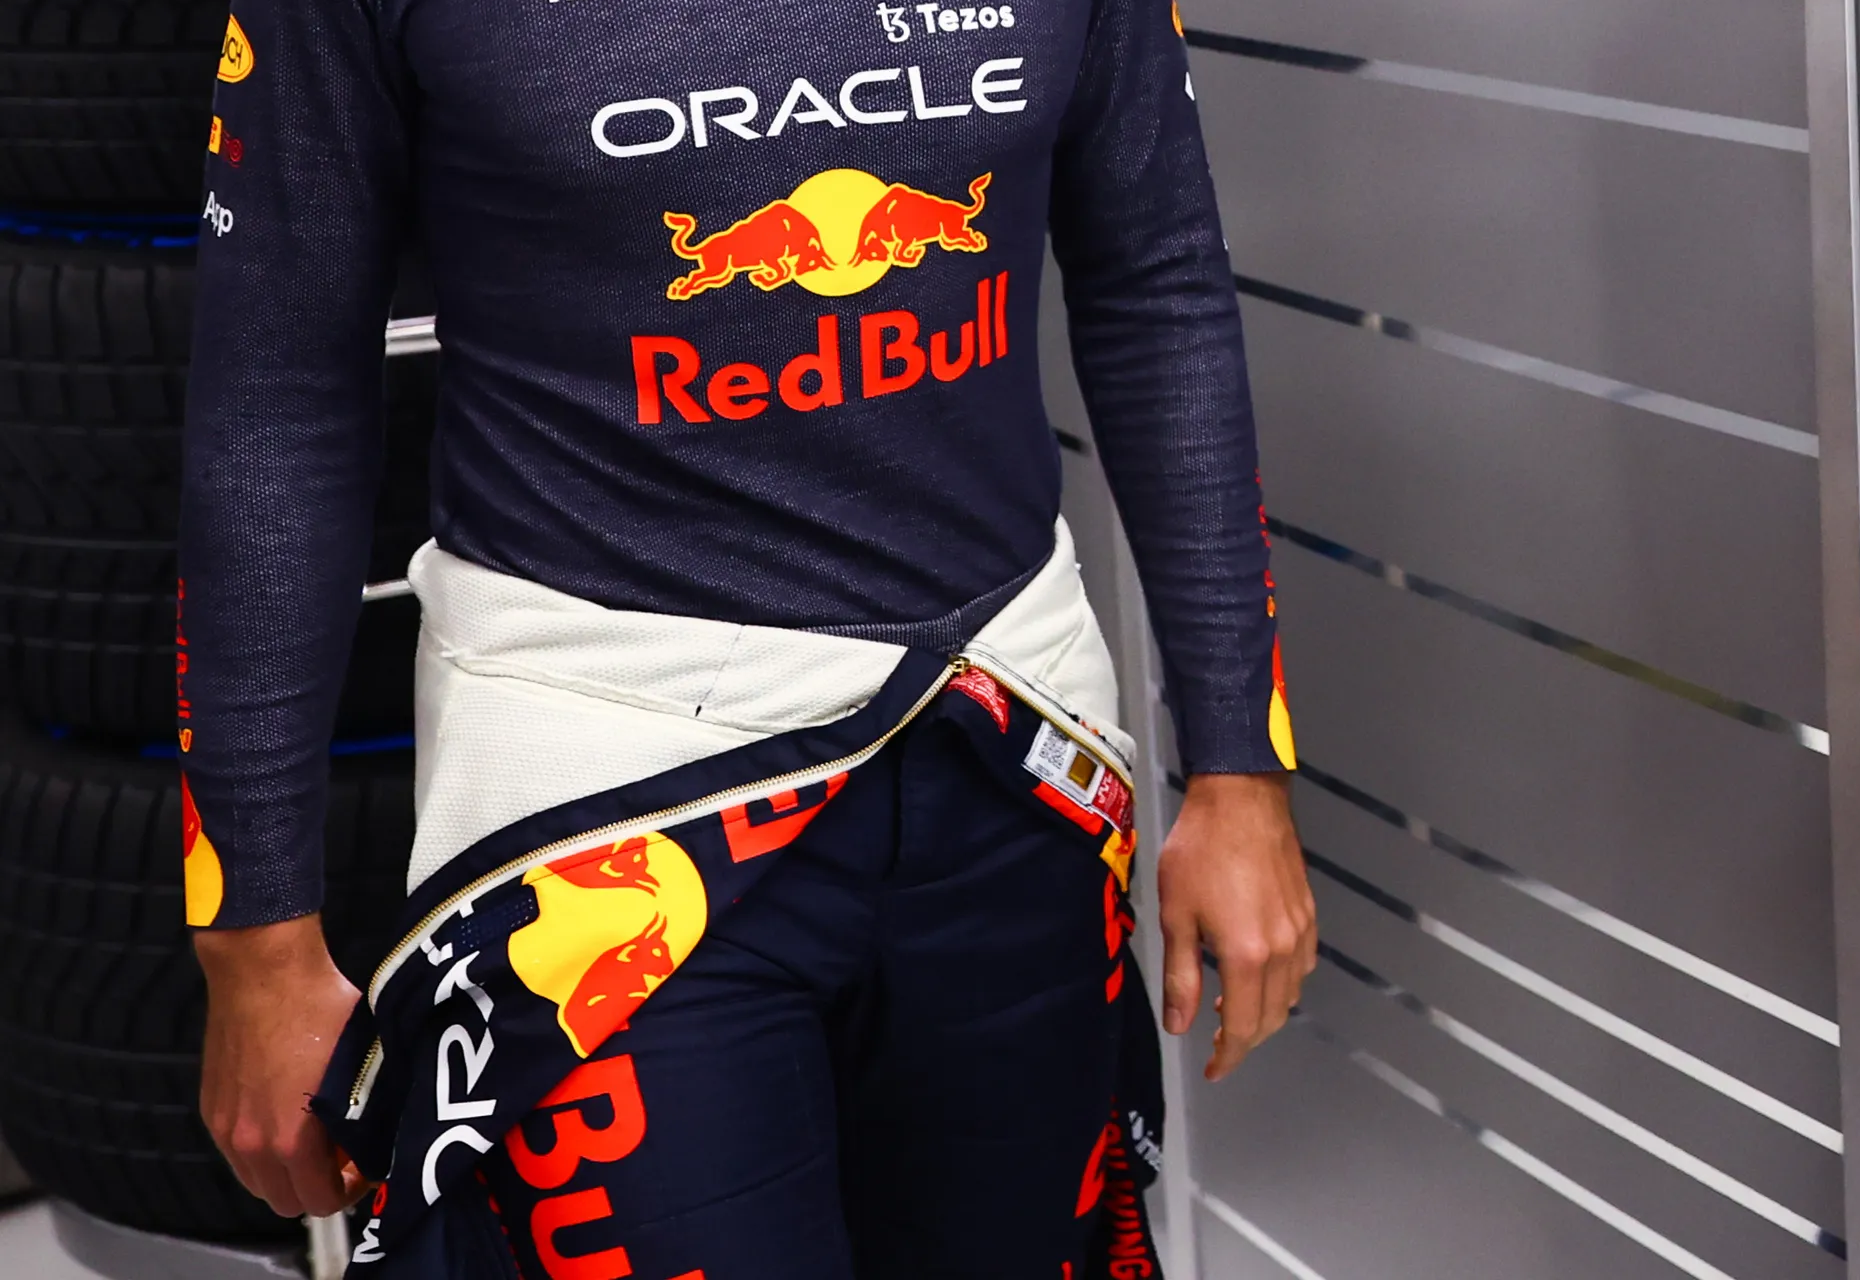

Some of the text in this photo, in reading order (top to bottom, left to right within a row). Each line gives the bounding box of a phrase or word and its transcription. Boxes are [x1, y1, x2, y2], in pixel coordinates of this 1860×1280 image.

[917, 4, 1015, 33] Tezos
[591, 57, 1028, 158] ORACLE
[629, 270, 1009, 424] Red Bull
